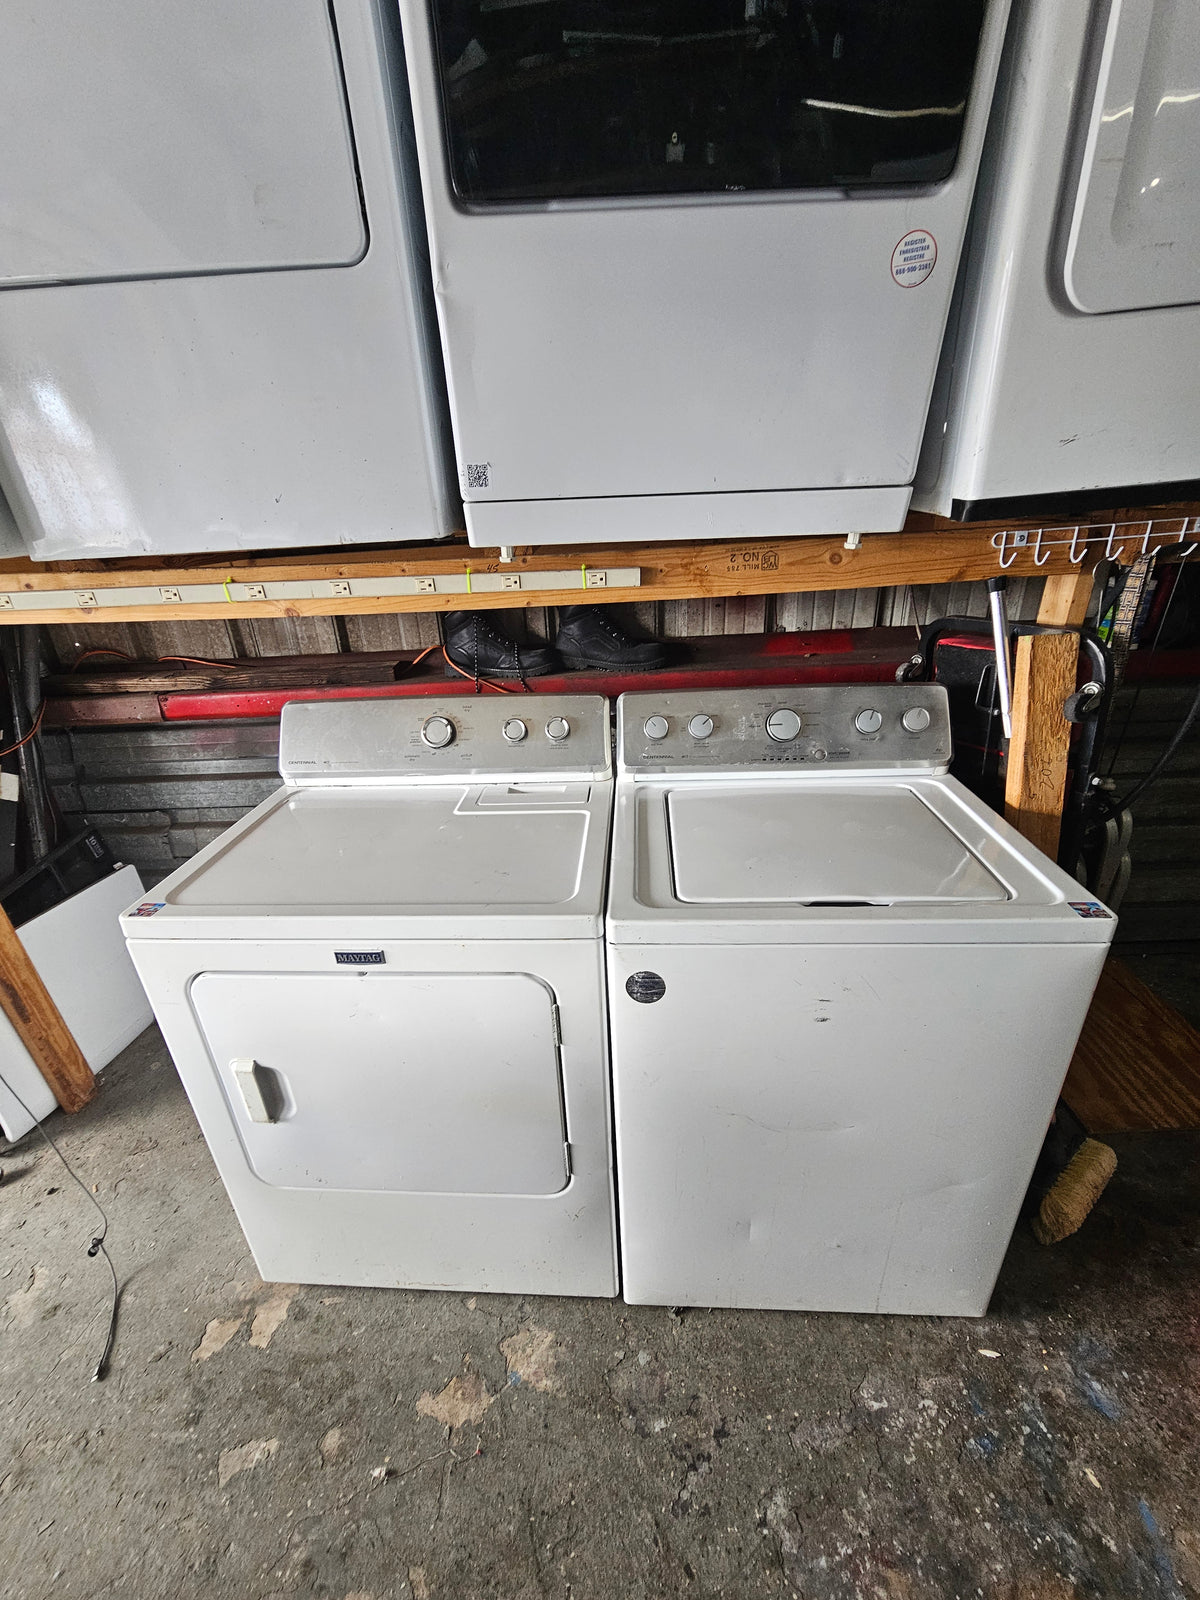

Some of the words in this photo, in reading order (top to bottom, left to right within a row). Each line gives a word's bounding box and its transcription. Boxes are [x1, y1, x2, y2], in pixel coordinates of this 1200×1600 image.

[904, 237, 926, 247] REGISTER
[730, 553, 737, 563] 2
[741, 551, 760, 562] NO.
[742, 563, 760, 571] MILL
[336, 953, 381, 963] MAYTAG
